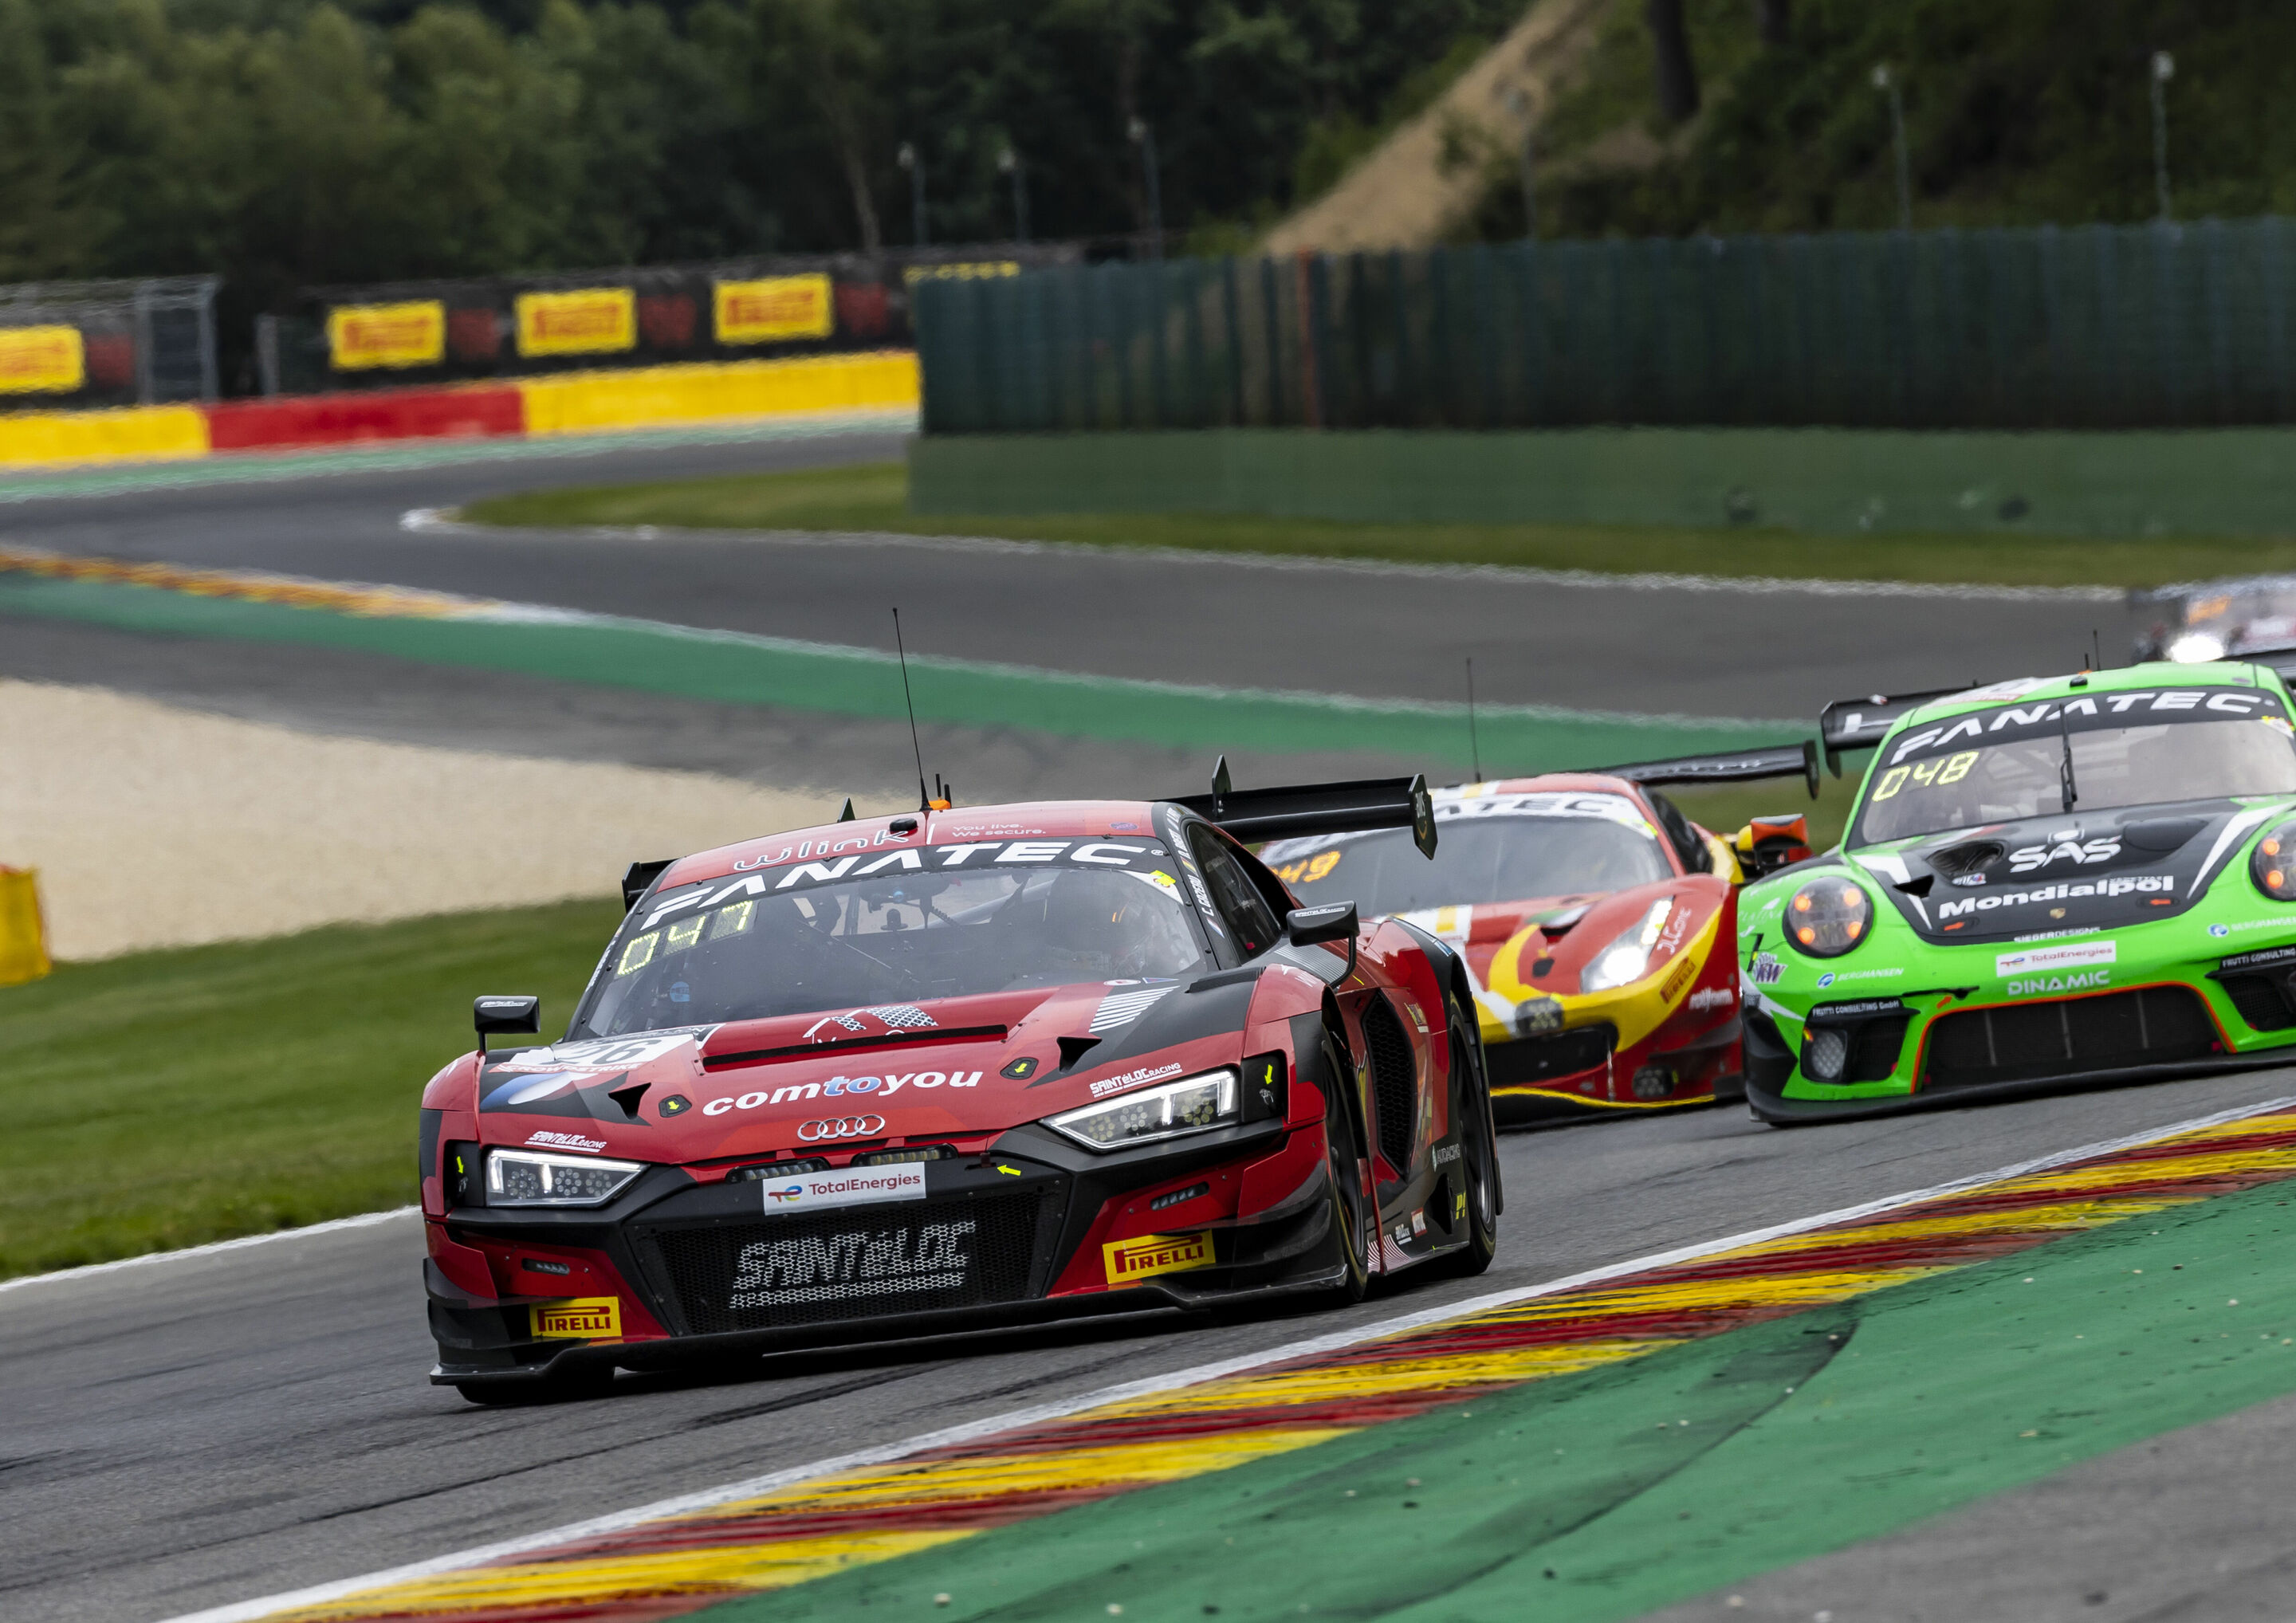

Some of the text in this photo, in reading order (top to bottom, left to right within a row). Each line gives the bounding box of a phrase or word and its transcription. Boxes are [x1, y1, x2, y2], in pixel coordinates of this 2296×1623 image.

[1890, 691, 2261, 764] FANATEC
[1873, 752, 1979, 802] 048
[2009, 835, 2121, 873] SAS
[640, 842, 1147, 931] FANATEC
[1938, 875, 2174, 918] Mondialpol
[618, 900, 753, 975] 047
[2031, 948, 2113, 961] TotalEnergies
[2007, 969, 2111, 996] DINAMIC
[702, 1070, 984, 1116] comtoyou
[808, 1173, 921, 1197] TotalEnergies
[1114, 1233, 1203, 1274] PIRELLI
[537, 1306, 611, 1333] PIRELLI
